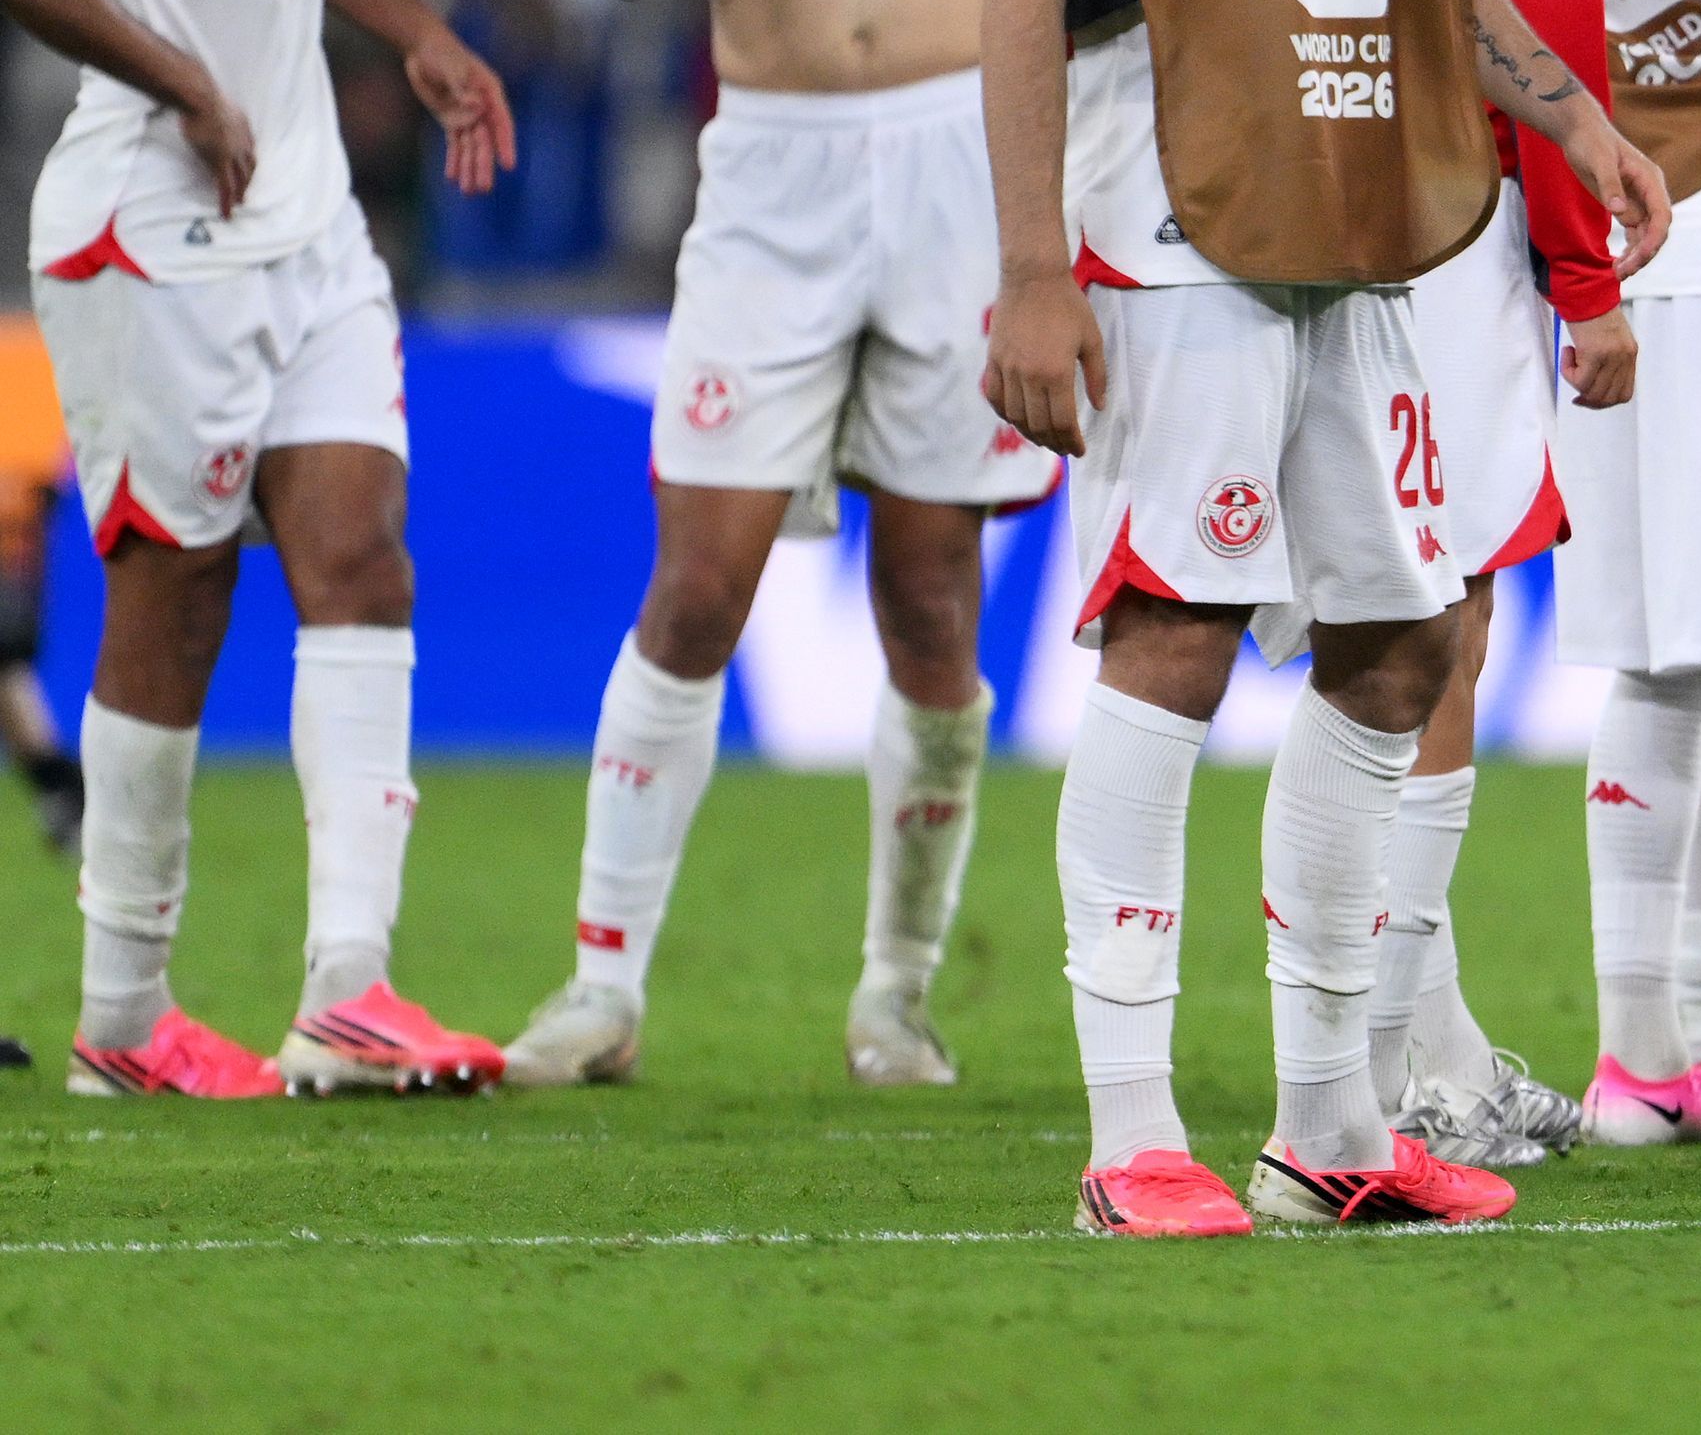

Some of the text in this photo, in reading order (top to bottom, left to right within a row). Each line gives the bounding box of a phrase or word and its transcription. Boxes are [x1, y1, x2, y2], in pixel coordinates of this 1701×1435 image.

[1289, 33, 1355, 63] WORLD
[1298, 69, 1394, 119] 2026
[1389, 391, 1445, 509] 26
